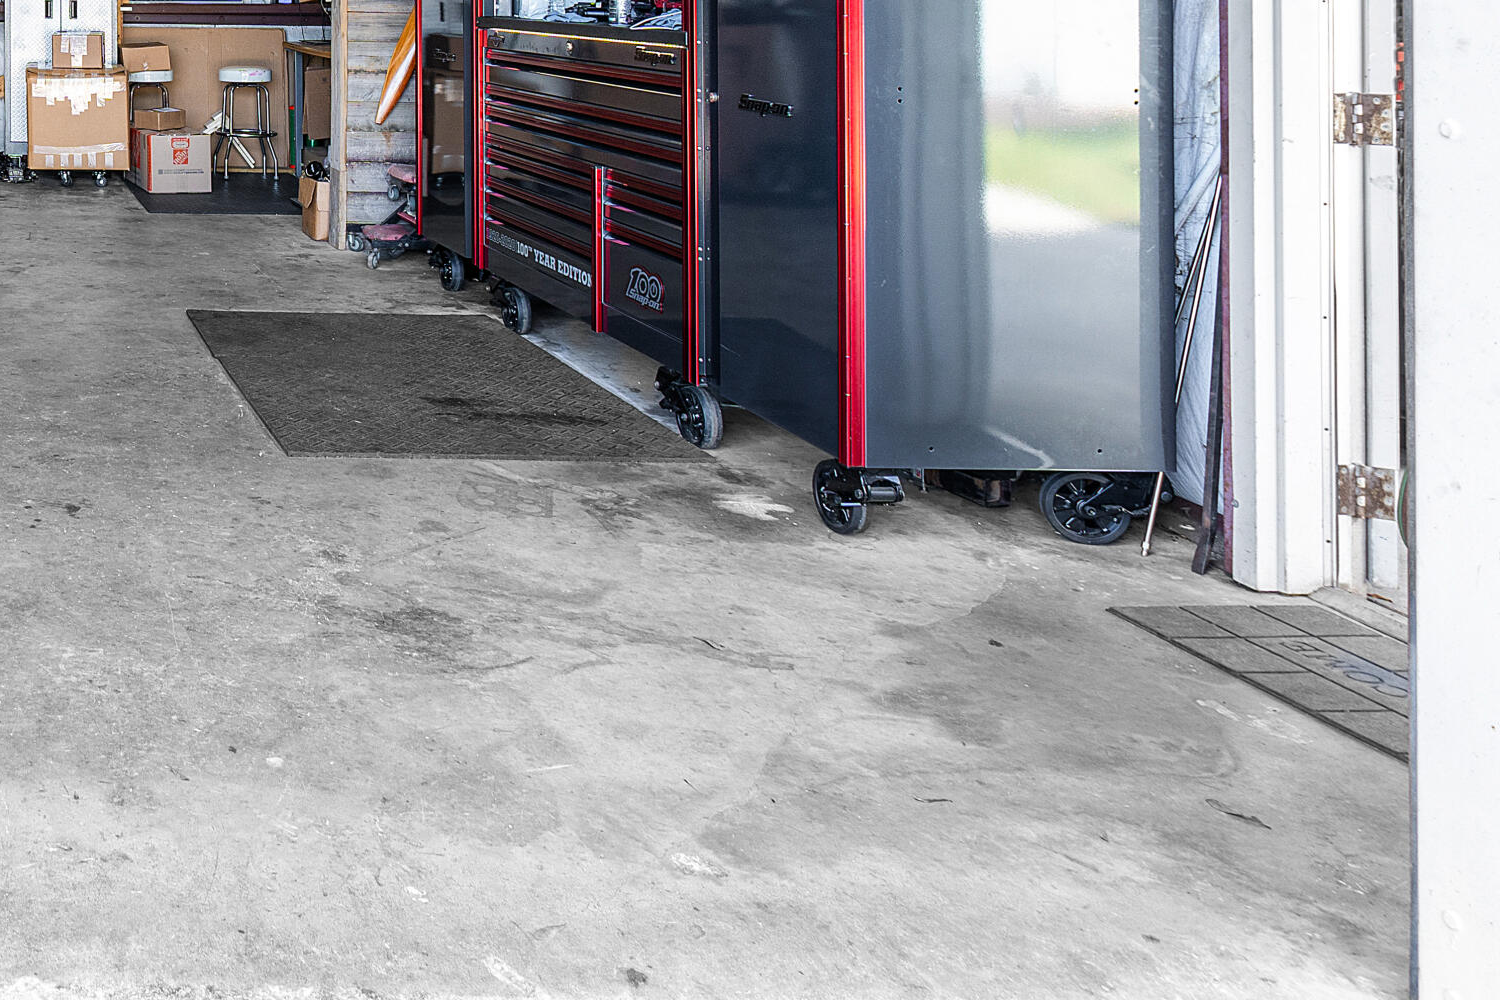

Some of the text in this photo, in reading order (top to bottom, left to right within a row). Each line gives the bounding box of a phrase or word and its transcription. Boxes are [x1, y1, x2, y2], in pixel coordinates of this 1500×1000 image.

[738, 93, 794, 118] Snap-on
[534, 248, 556, 272] YEAR
[626, 267, 662, 303] 100
[627, 288, 663, 311] Snap-on
